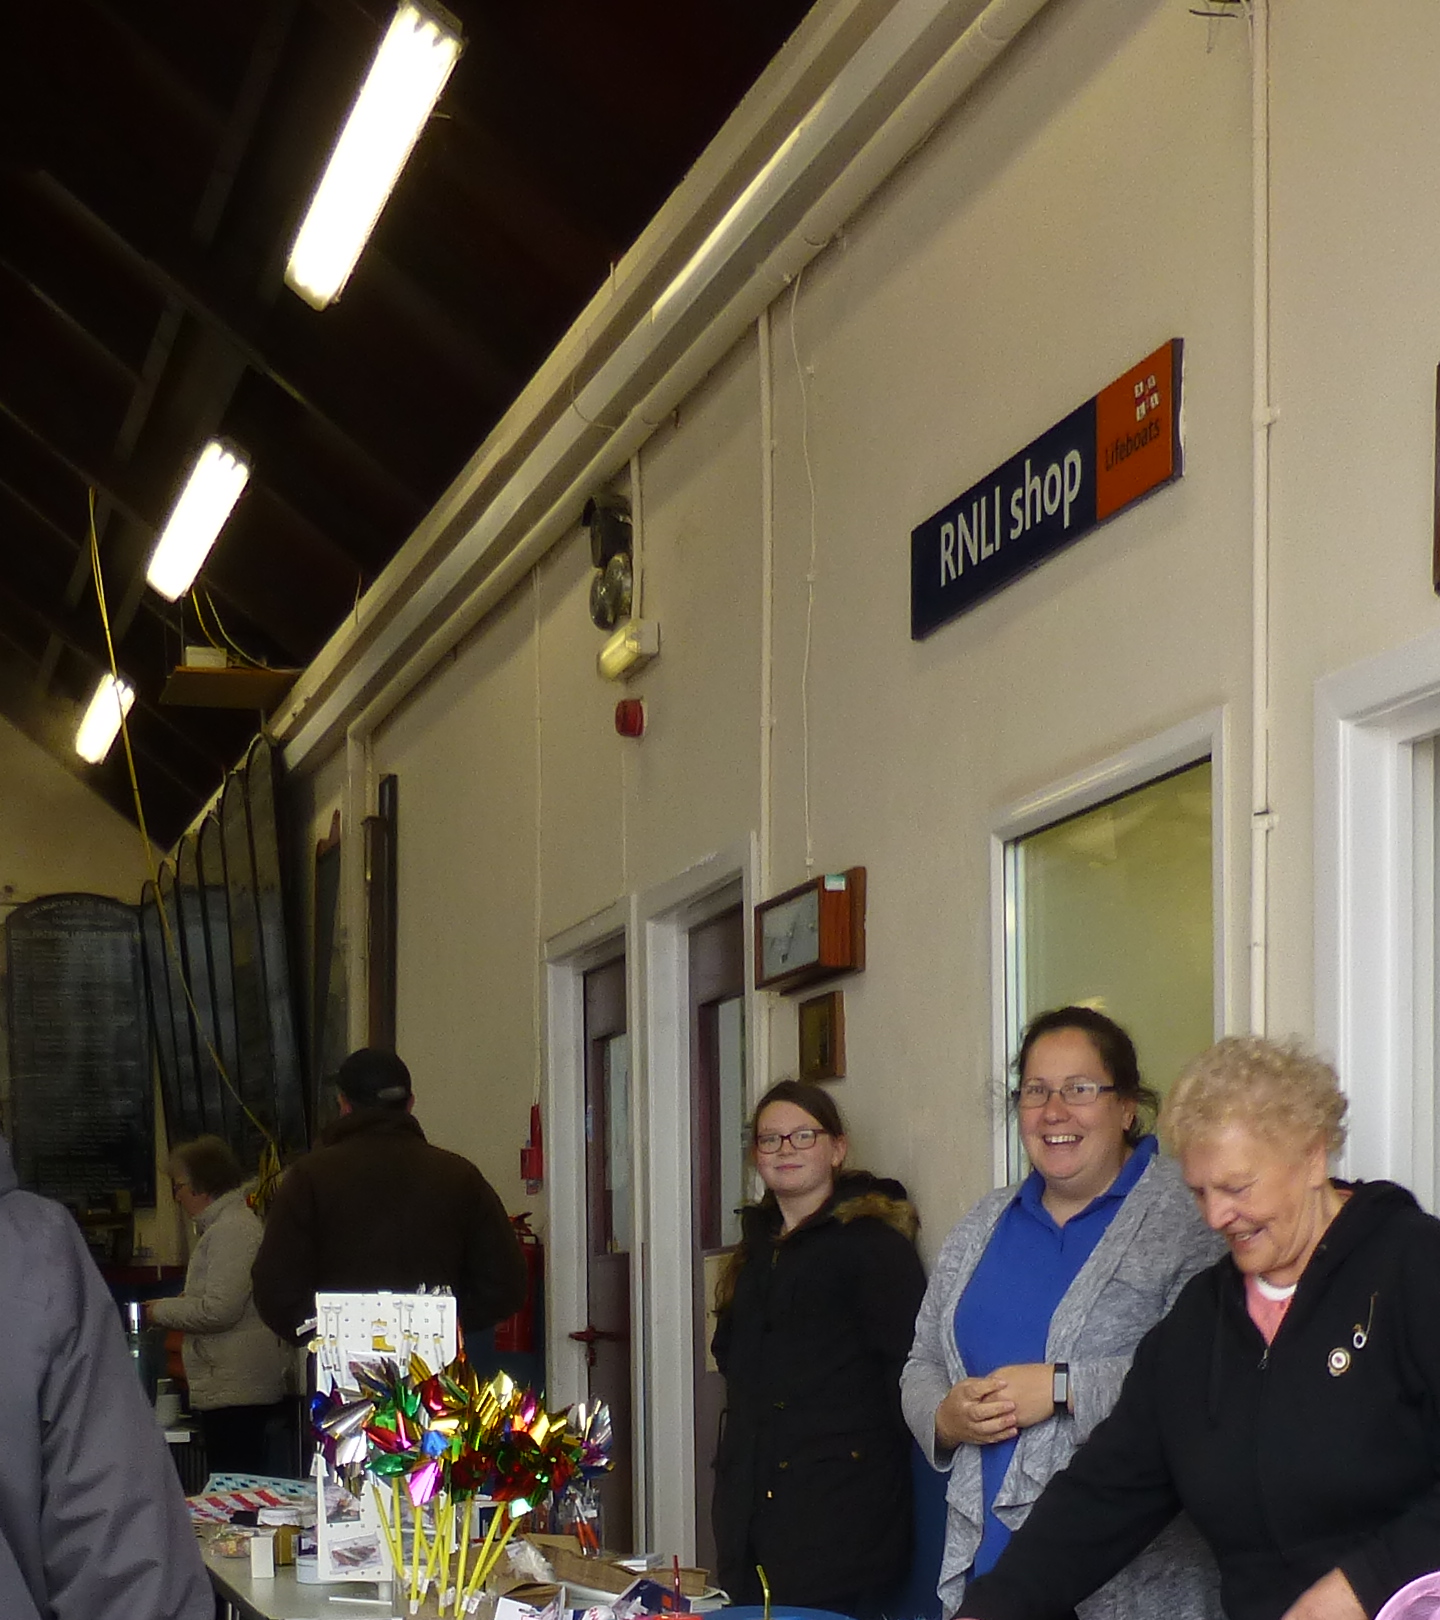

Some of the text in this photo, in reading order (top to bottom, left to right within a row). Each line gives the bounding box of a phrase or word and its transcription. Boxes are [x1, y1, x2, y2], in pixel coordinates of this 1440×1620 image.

[1104, 417, 1161, 472] Lifeboats
[940, 448, 1083, 588] RNLI shop
